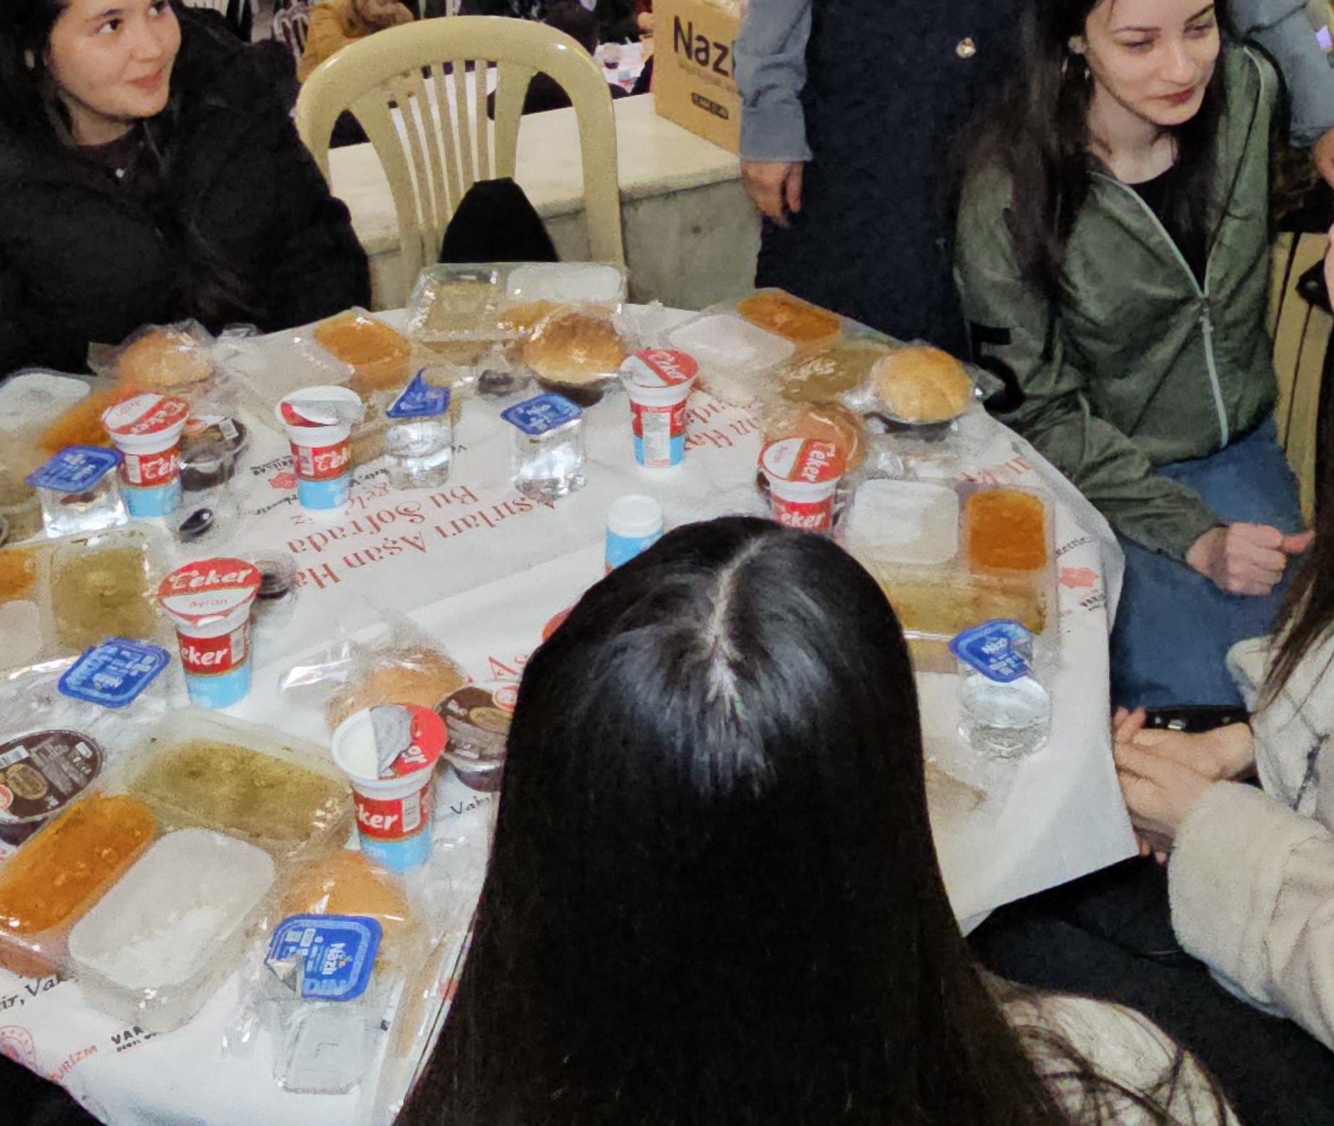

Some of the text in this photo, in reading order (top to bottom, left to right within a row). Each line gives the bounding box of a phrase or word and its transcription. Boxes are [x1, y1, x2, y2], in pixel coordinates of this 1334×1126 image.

[429, 485, 480, 510] Bu
[285, 500, 426, 554] Sofrada
[295, 562, 340, 590] Ha
